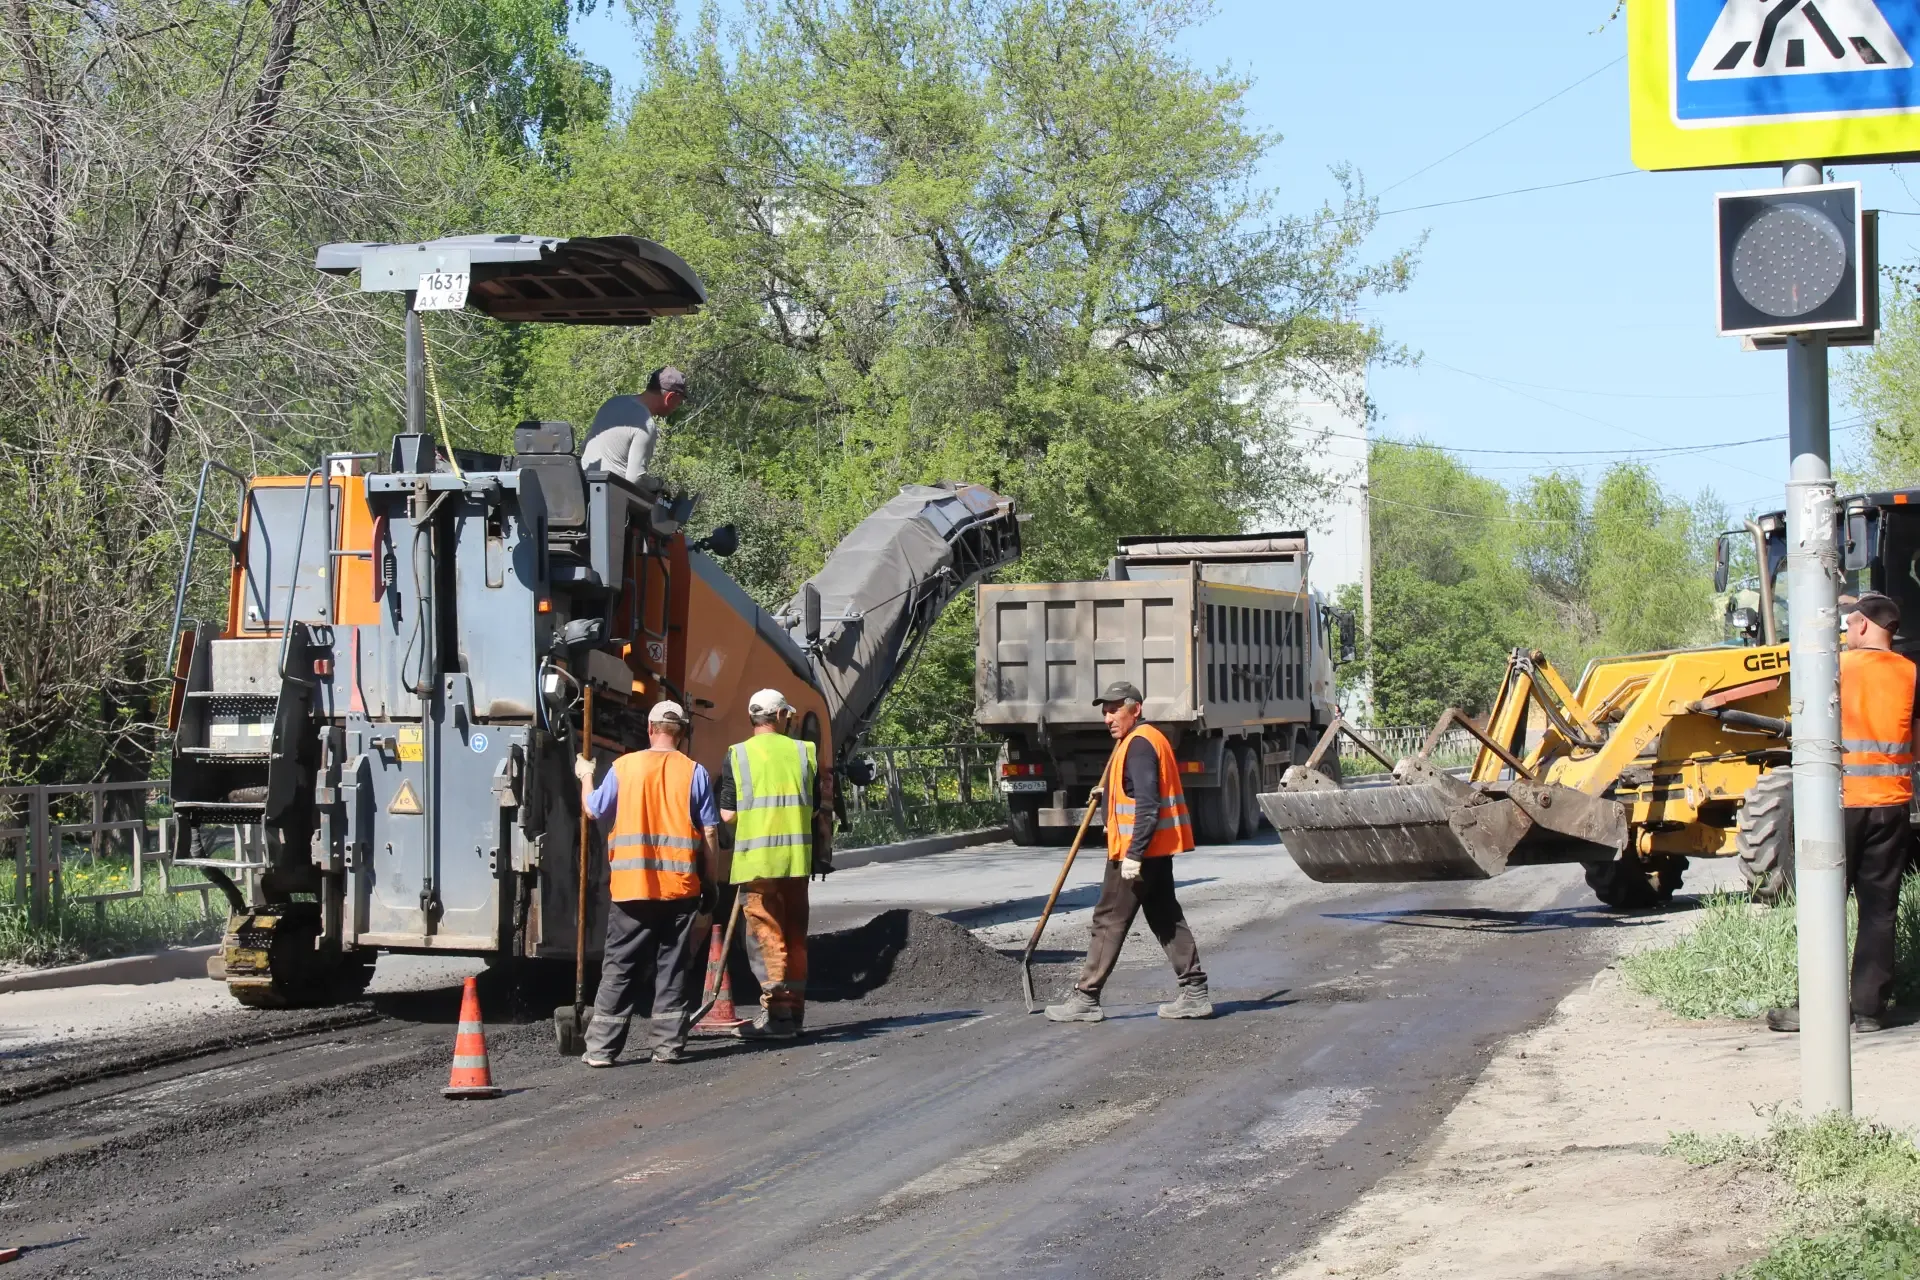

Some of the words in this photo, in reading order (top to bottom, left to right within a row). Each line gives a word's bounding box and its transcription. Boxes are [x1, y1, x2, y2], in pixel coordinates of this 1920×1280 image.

[427, 274, 463, 290] 1631
[447, 292, 463, 303] 63
[1744, 650, 1790, 671] GEH
